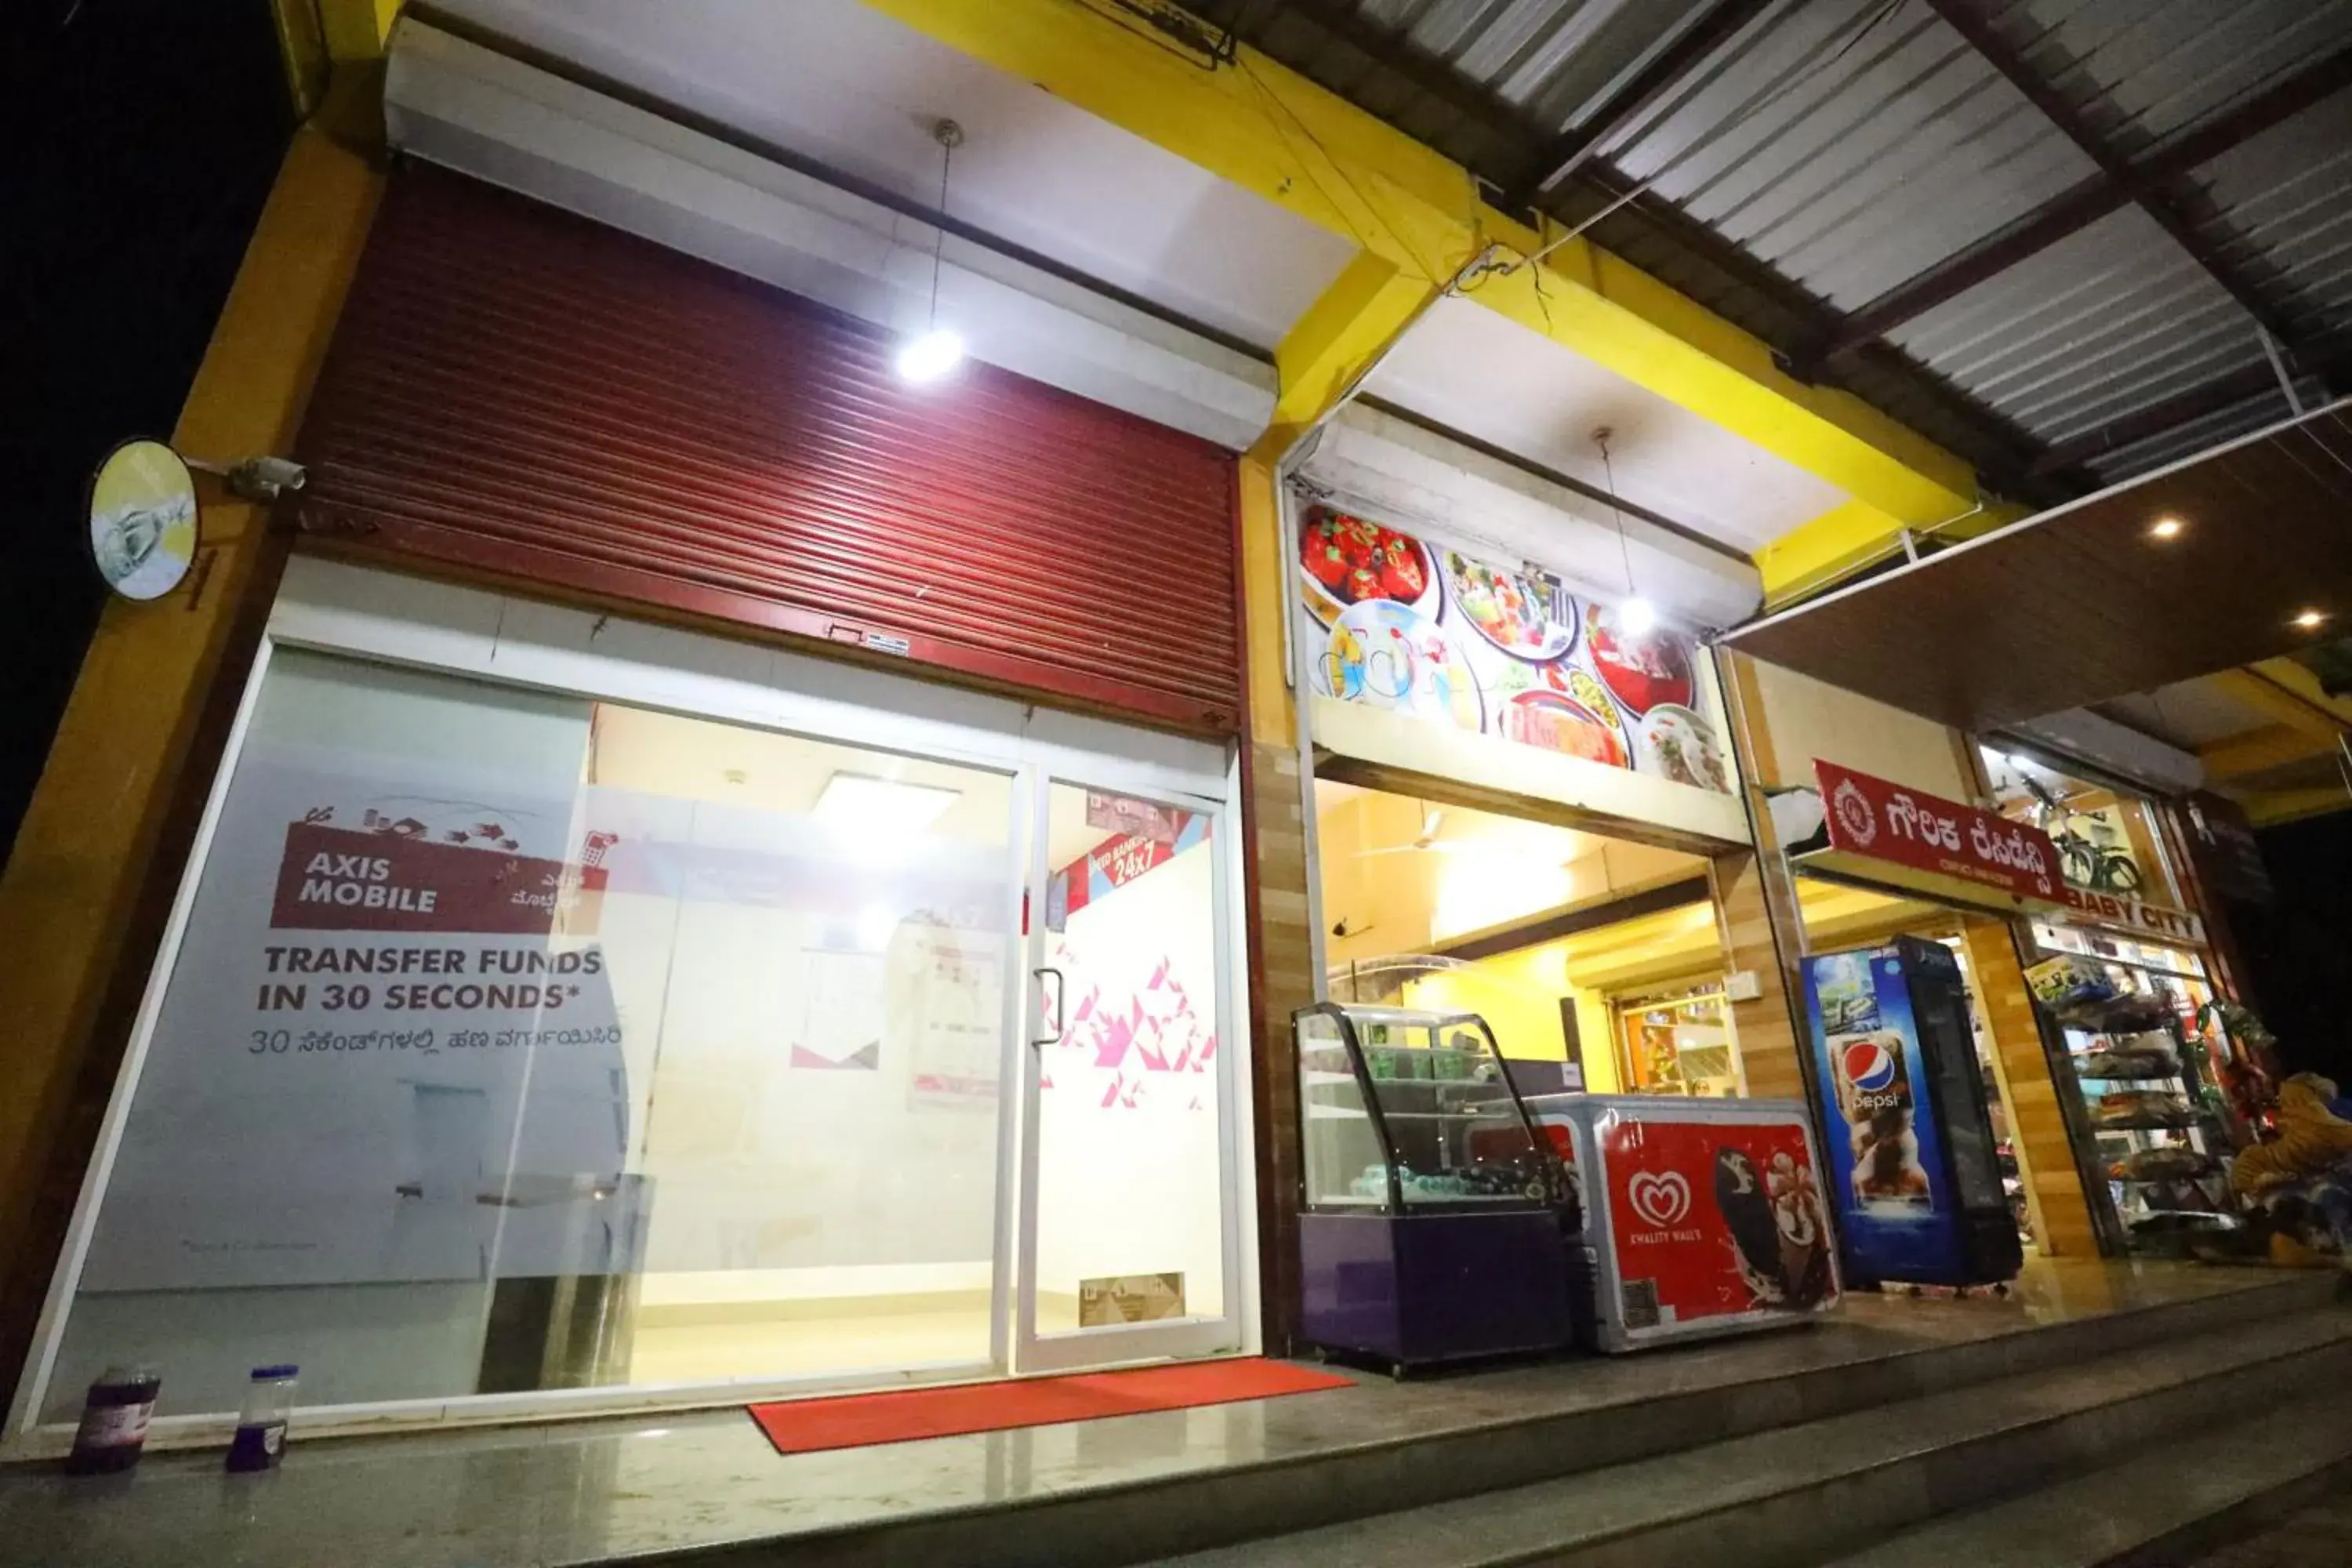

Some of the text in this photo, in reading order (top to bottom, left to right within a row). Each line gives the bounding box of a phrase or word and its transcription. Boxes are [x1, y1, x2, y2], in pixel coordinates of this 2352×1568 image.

[306, 852, 390, 879] AXIS
[298, 879, 437, 913] MOBILE
[2067, 889, 2194, 938] BABY CITY
[264, 946, 601, 975] TRANSFER FUNDS
[256, 983, 307, 1011] IN
[320, 983, 370, 1011] 30
[249, 1029, 290, 1054] 30
[1853, 1092, 1900, 1111] pepsi
